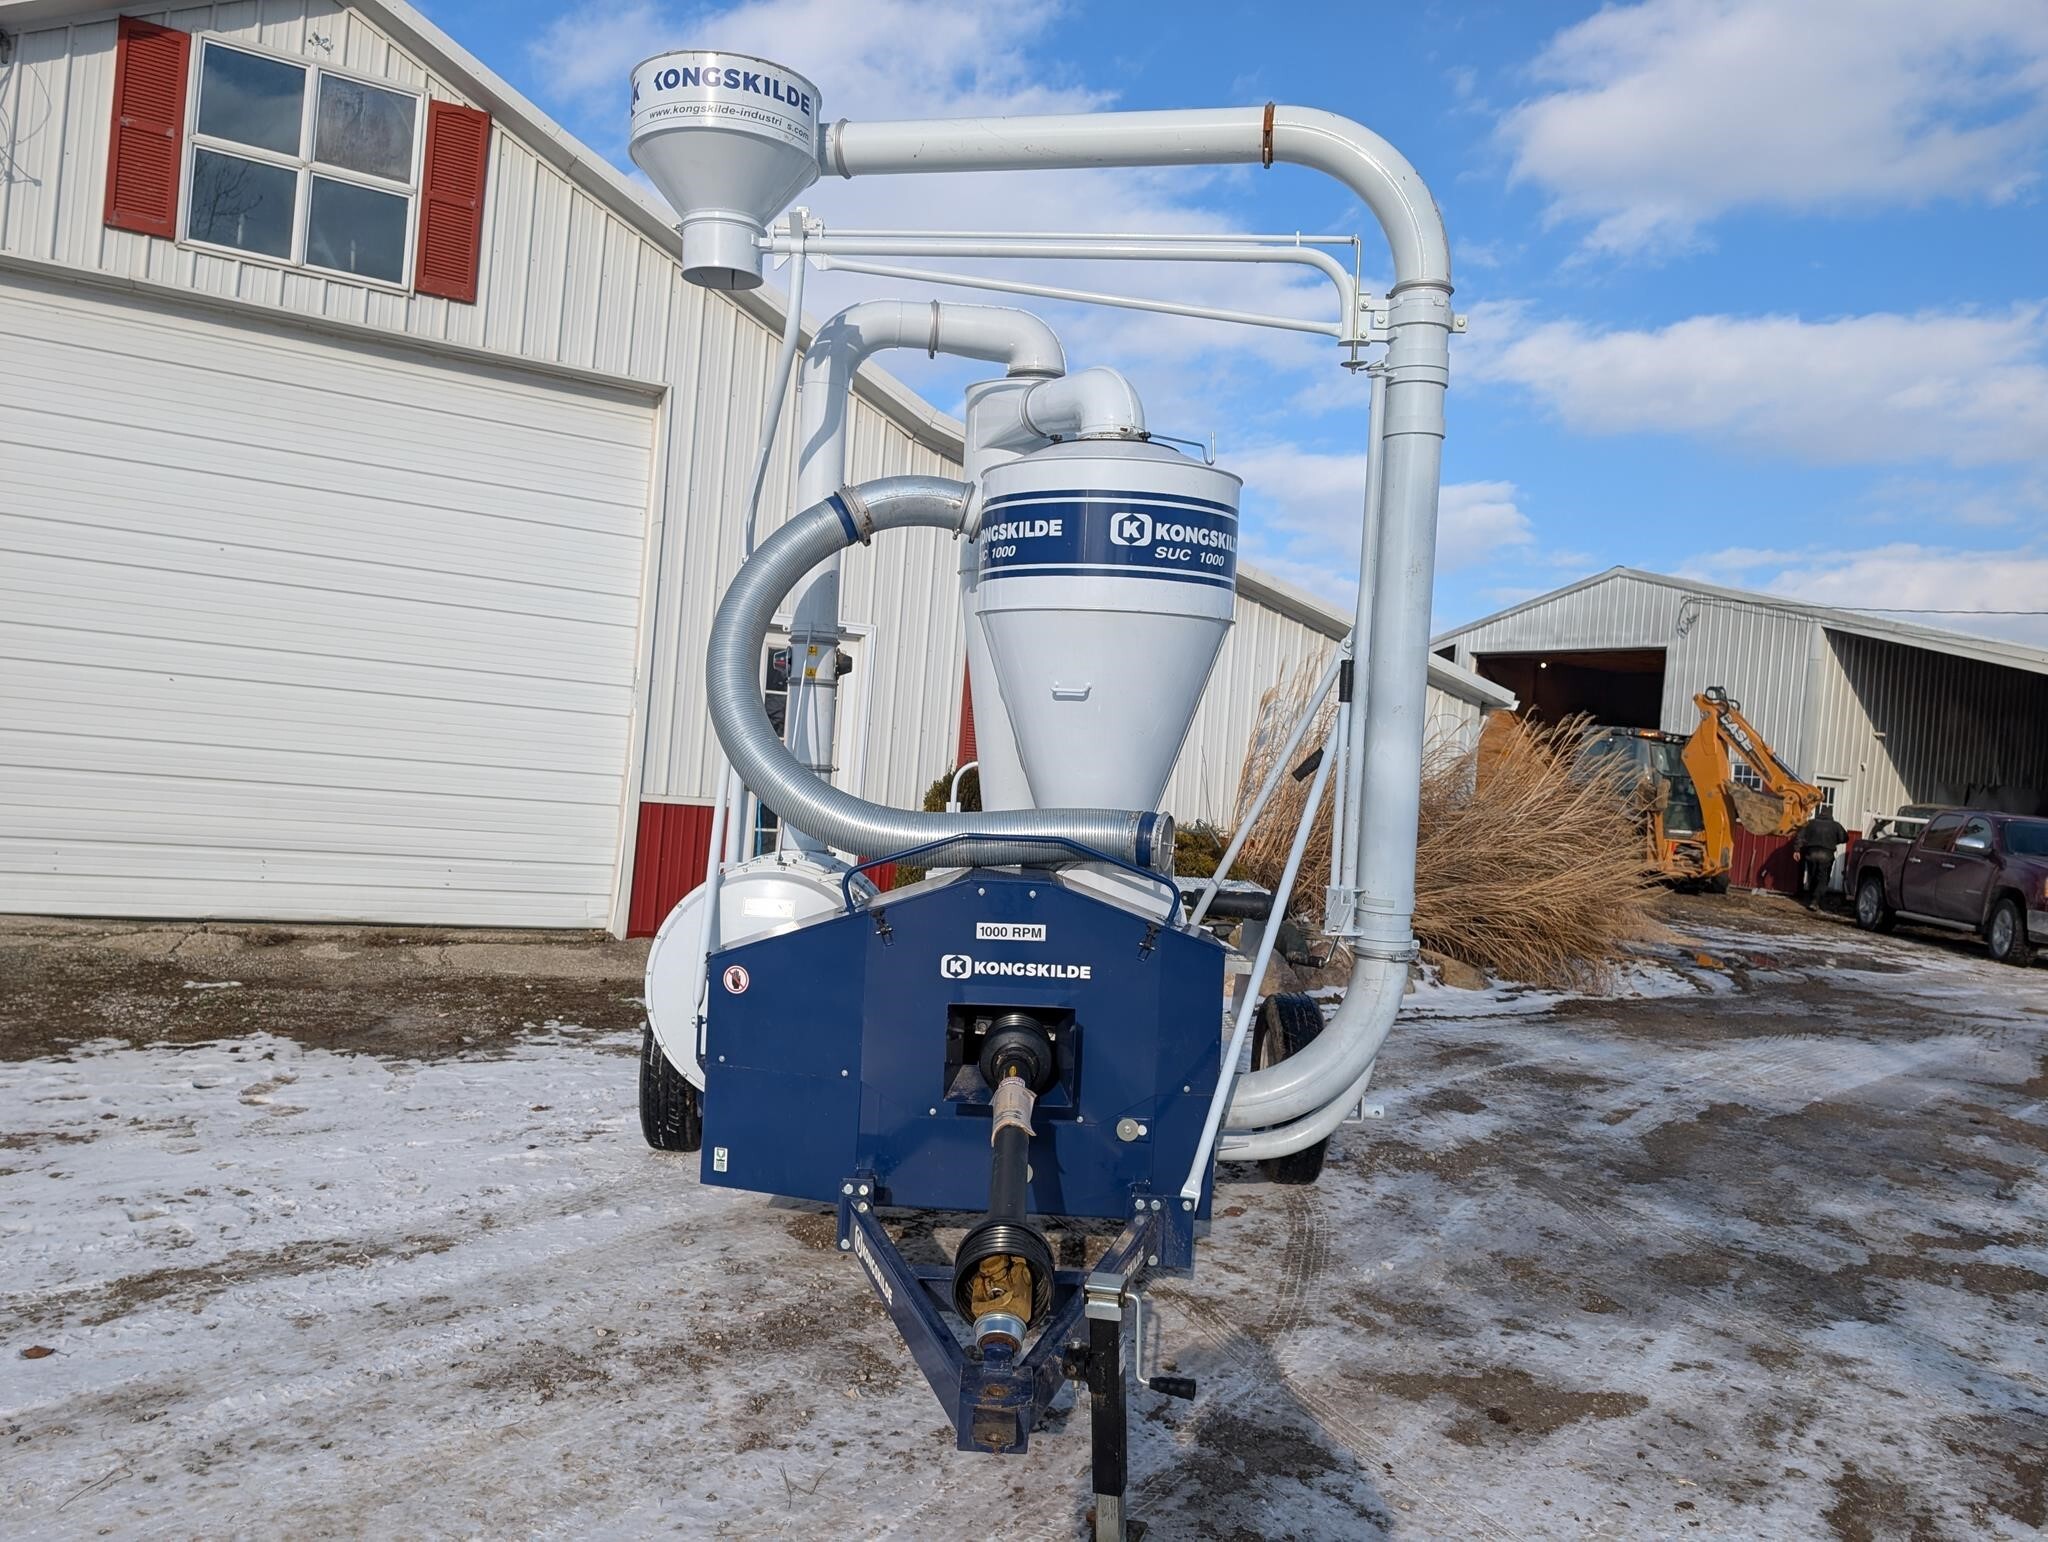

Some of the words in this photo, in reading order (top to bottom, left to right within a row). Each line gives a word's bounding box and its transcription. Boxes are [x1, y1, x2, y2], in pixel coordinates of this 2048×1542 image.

[650, 104, 809, 140] www.kongskilde-industris.com
[981, 519, 1063, 544] ONGSKILDE
[1155, 522, 1237, 552] KONGSKIL
[992, 545, 1016, 559] 1000
[1155, 546, 1192, 560] SUC
[1200, 551, 1225, 567] 1000
[1720, 712, 1752, 751] CASE
[979, 926, 1008, 937] 1000
[1012, 927, 1042, 938] RPM
[974, 961, 1091, 979] KONGSKILDE
